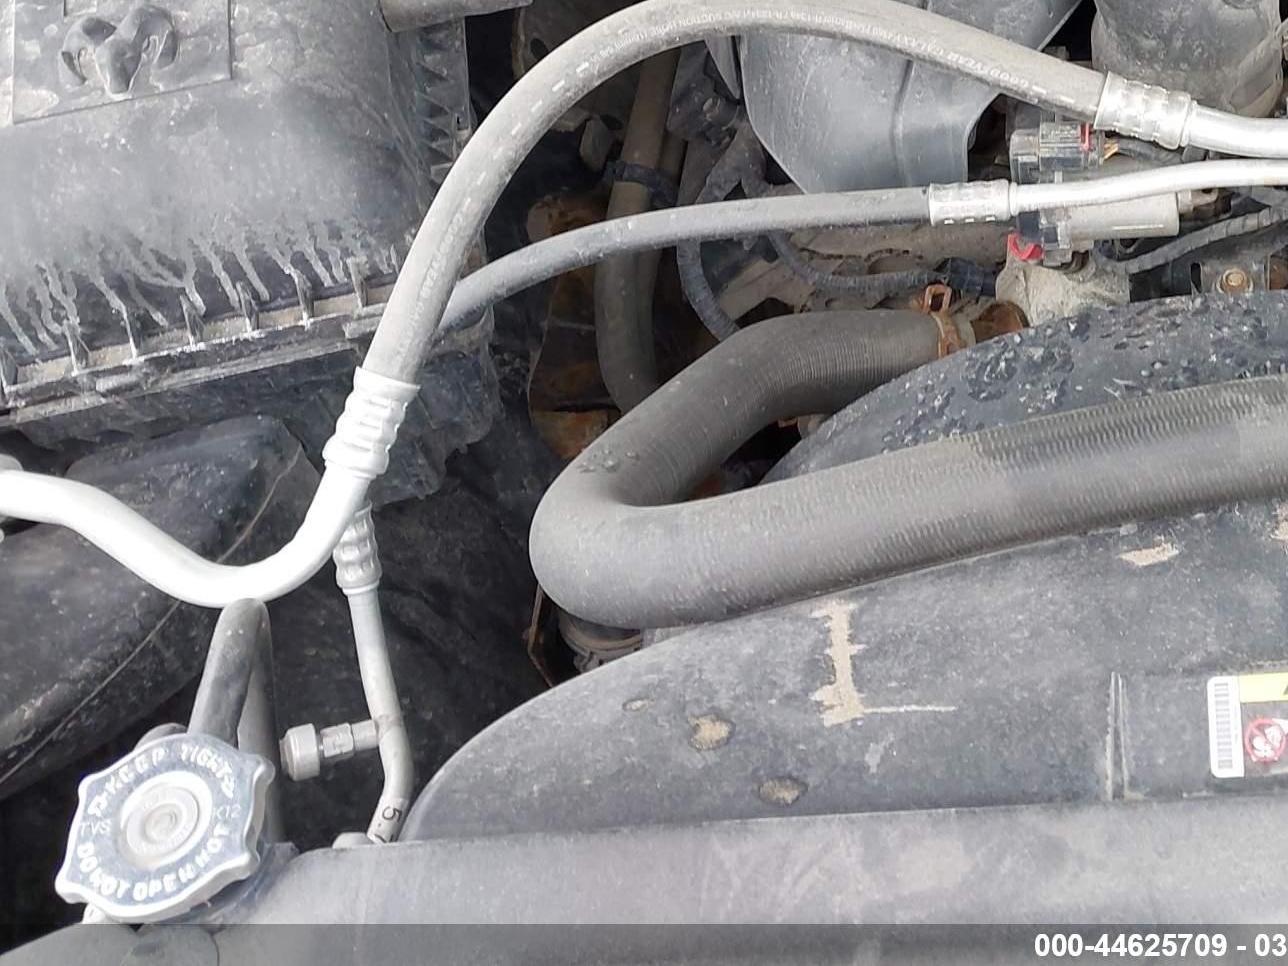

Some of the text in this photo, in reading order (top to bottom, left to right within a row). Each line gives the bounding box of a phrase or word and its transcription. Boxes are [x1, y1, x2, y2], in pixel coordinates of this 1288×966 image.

[648, 18, 677, 37] HOSE
[678, 10, 723, 26] SUCTION
[895, 33, 945, 57] GALAXY
[946, 51, 1030, 89] GOODYEAR
[105, 743, 234, 795] KEEP TIGHT
[79, 818, 112, 835] TVS
[76, 841, 98, 873] DO
[89, 865, 131, 900] NOT
[132, 863, 196, 902] OPEN
[194, 822, 231, 868] HOT
